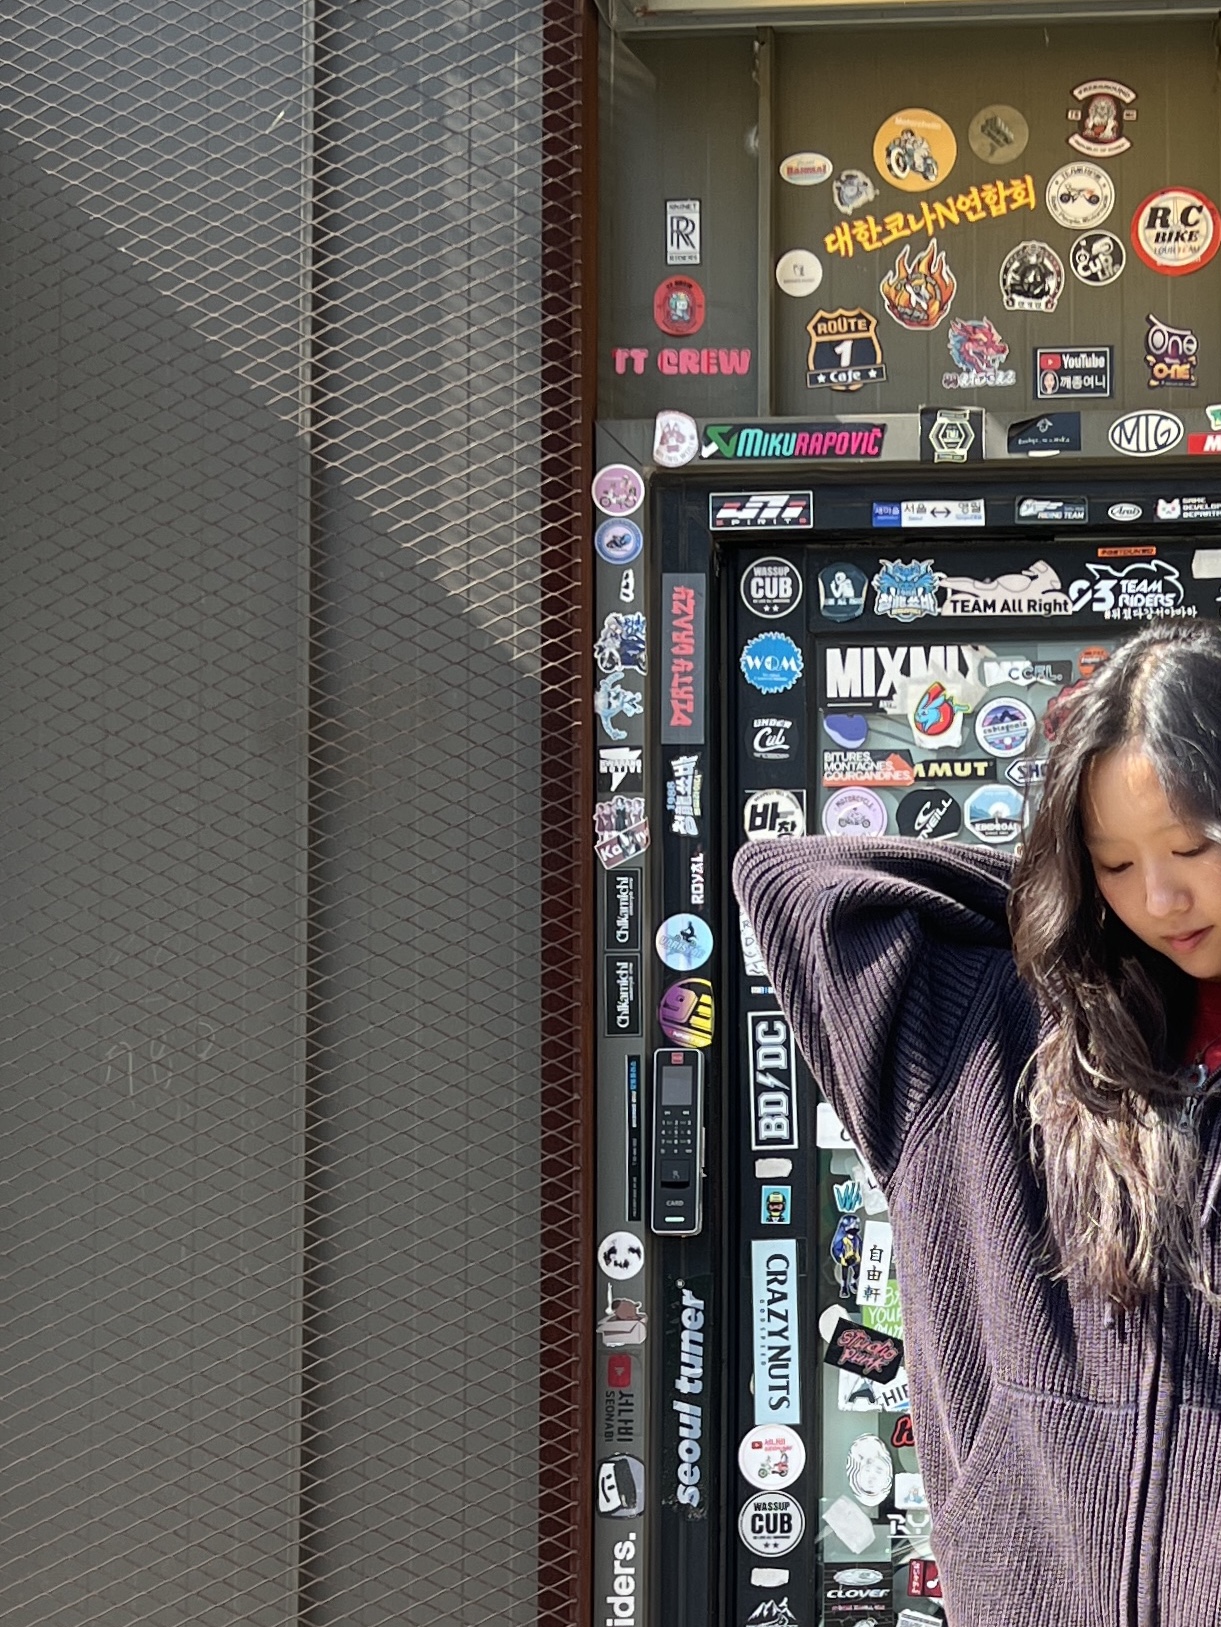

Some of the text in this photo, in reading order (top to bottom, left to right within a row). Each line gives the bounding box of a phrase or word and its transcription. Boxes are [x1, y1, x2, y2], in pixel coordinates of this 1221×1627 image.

[823, 174, 1037, 258] 대한코나N연합회
[1154, 230, 1200, 244] BIKE
[817, 317, 868, 335] ROUTE
[657, 348, 751, 375] CREW
[834, 339, 854, 367] 1
[1062, 354, 1105, 369] YouTube
[829, 370, 862, 384] Cafe
[753, 566, 790, 577] WASSUP
[750, 577, 793, 599] CUB
[1120, 580, 1162, 592] TEAM
[951, 598, 1069, 615] TEAM All Right
[1118, 594, 1176, 607] RIDERS
[753, 719, 792, 729] UNDER
[691, 852, 704, 904] ROYAL
[755, 1020, 789, 1140] BD DC
[863, 1245, 884, 1303] 自由軒
[765, 1253, 792, 1411] CRAZY NUTS
[673, 1289, 705, 1507] seoul tuner
[605, 1390, 614, 1442] SEONABI
[753, 1502, 789, 1512] WASSUP
[751, 1513, 793, 1534] CUB
[827, 1589, 891, 1598] CLOVER
